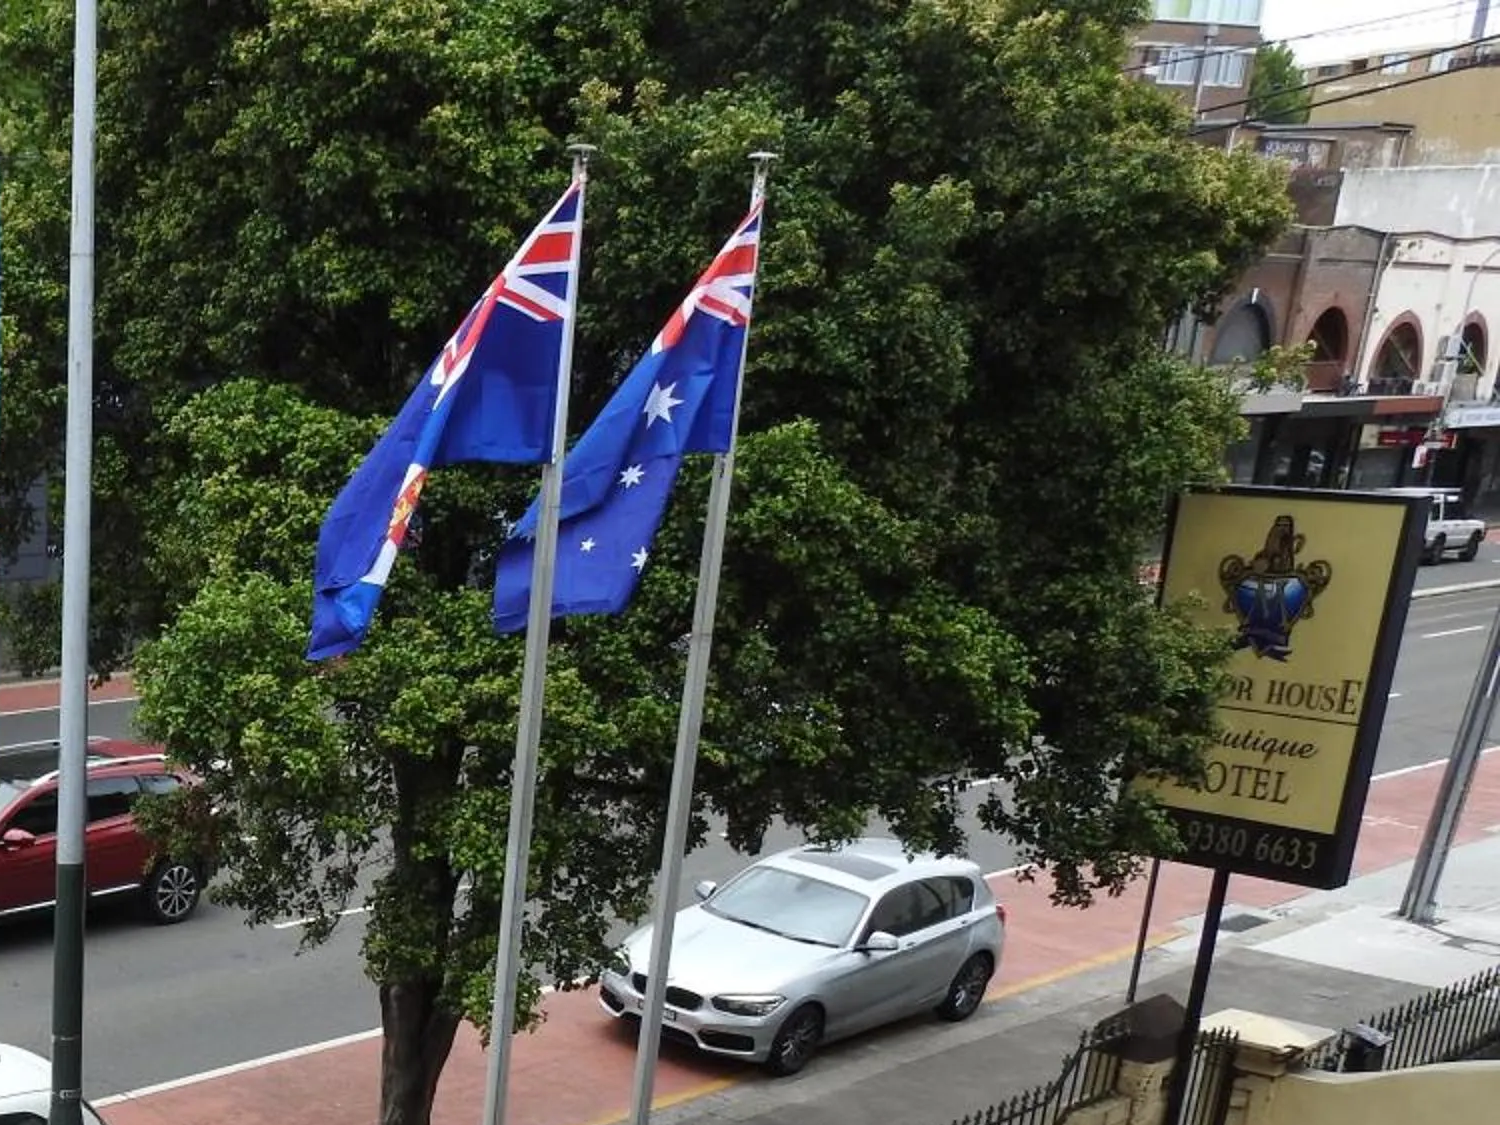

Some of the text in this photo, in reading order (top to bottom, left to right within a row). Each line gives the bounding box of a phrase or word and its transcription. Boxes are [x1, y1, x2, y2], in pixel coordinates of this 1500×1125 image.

[1266, 679, 1362, 716] HOUSE
[1172, 760, 1290, 805] OTEL
[1187, 820, 1318, 870] 9380 6633
